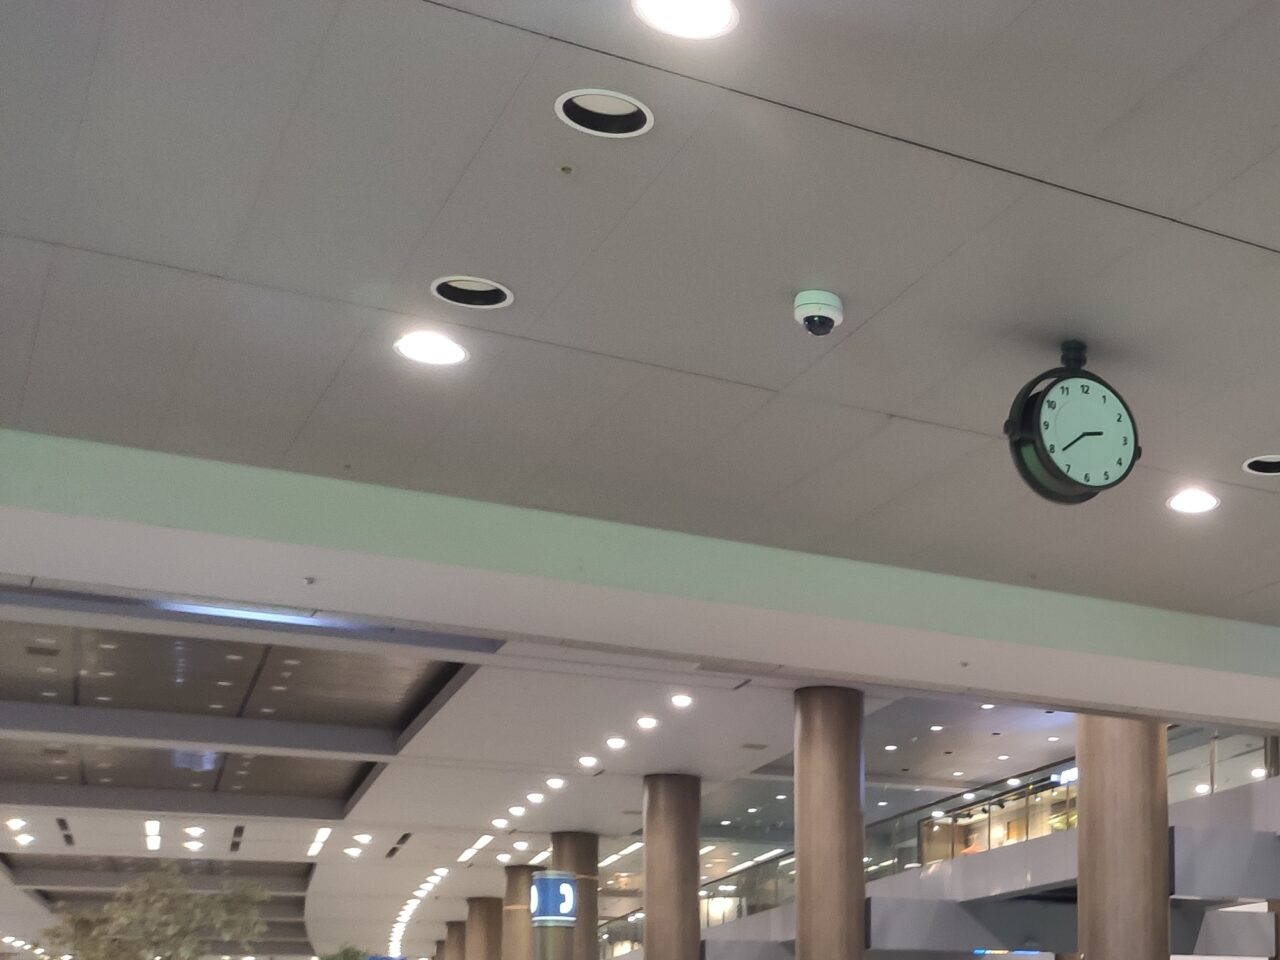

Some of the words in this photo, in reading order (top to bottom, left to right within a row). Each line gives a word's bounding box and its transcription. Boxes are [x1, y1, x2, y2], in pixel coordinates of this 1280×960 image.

[1060, 386, 1070, 396] 11
[1080, 385, 1090, 395] 12
[1046, 399, 1057, 411] 10
[1101, 395, 1107, 405] 1
[1116, 413, 1123, 423] 2
[1043, 421, 1050, 430] 9
[1122, 436, 1128, 446] 3
[1049, 444, 1055, 454] 8
[1116, 457, 1123, 467] 4
[1065, 464, 1071, 474] 7
[1084, 472, 1090, 482] 6
[1104, 471, 1110, 481] 5
